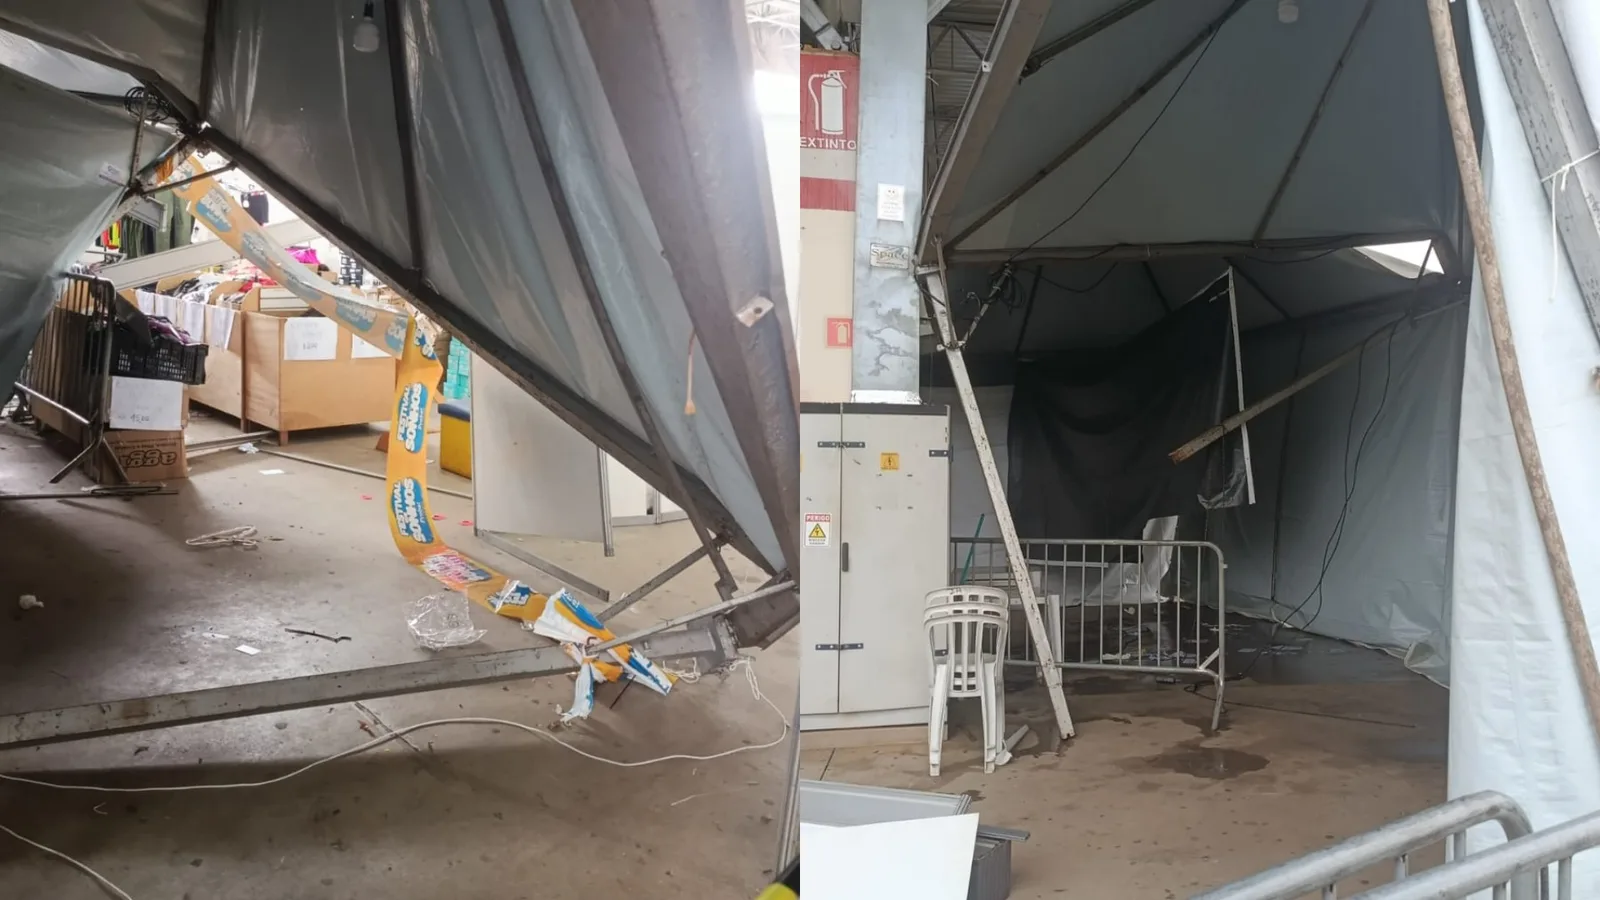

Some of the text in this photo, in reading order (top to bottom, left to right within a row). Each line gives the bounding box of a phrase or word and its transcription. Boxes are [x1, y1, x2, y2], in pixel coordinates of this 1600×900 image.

[397, 385, 410, 441] FESTIVAL
[405, 383, 422, 452] SONHOS
[394, 481, 409, 536] FESTIVAL
[403, 478, 427, 543] SONHOS
